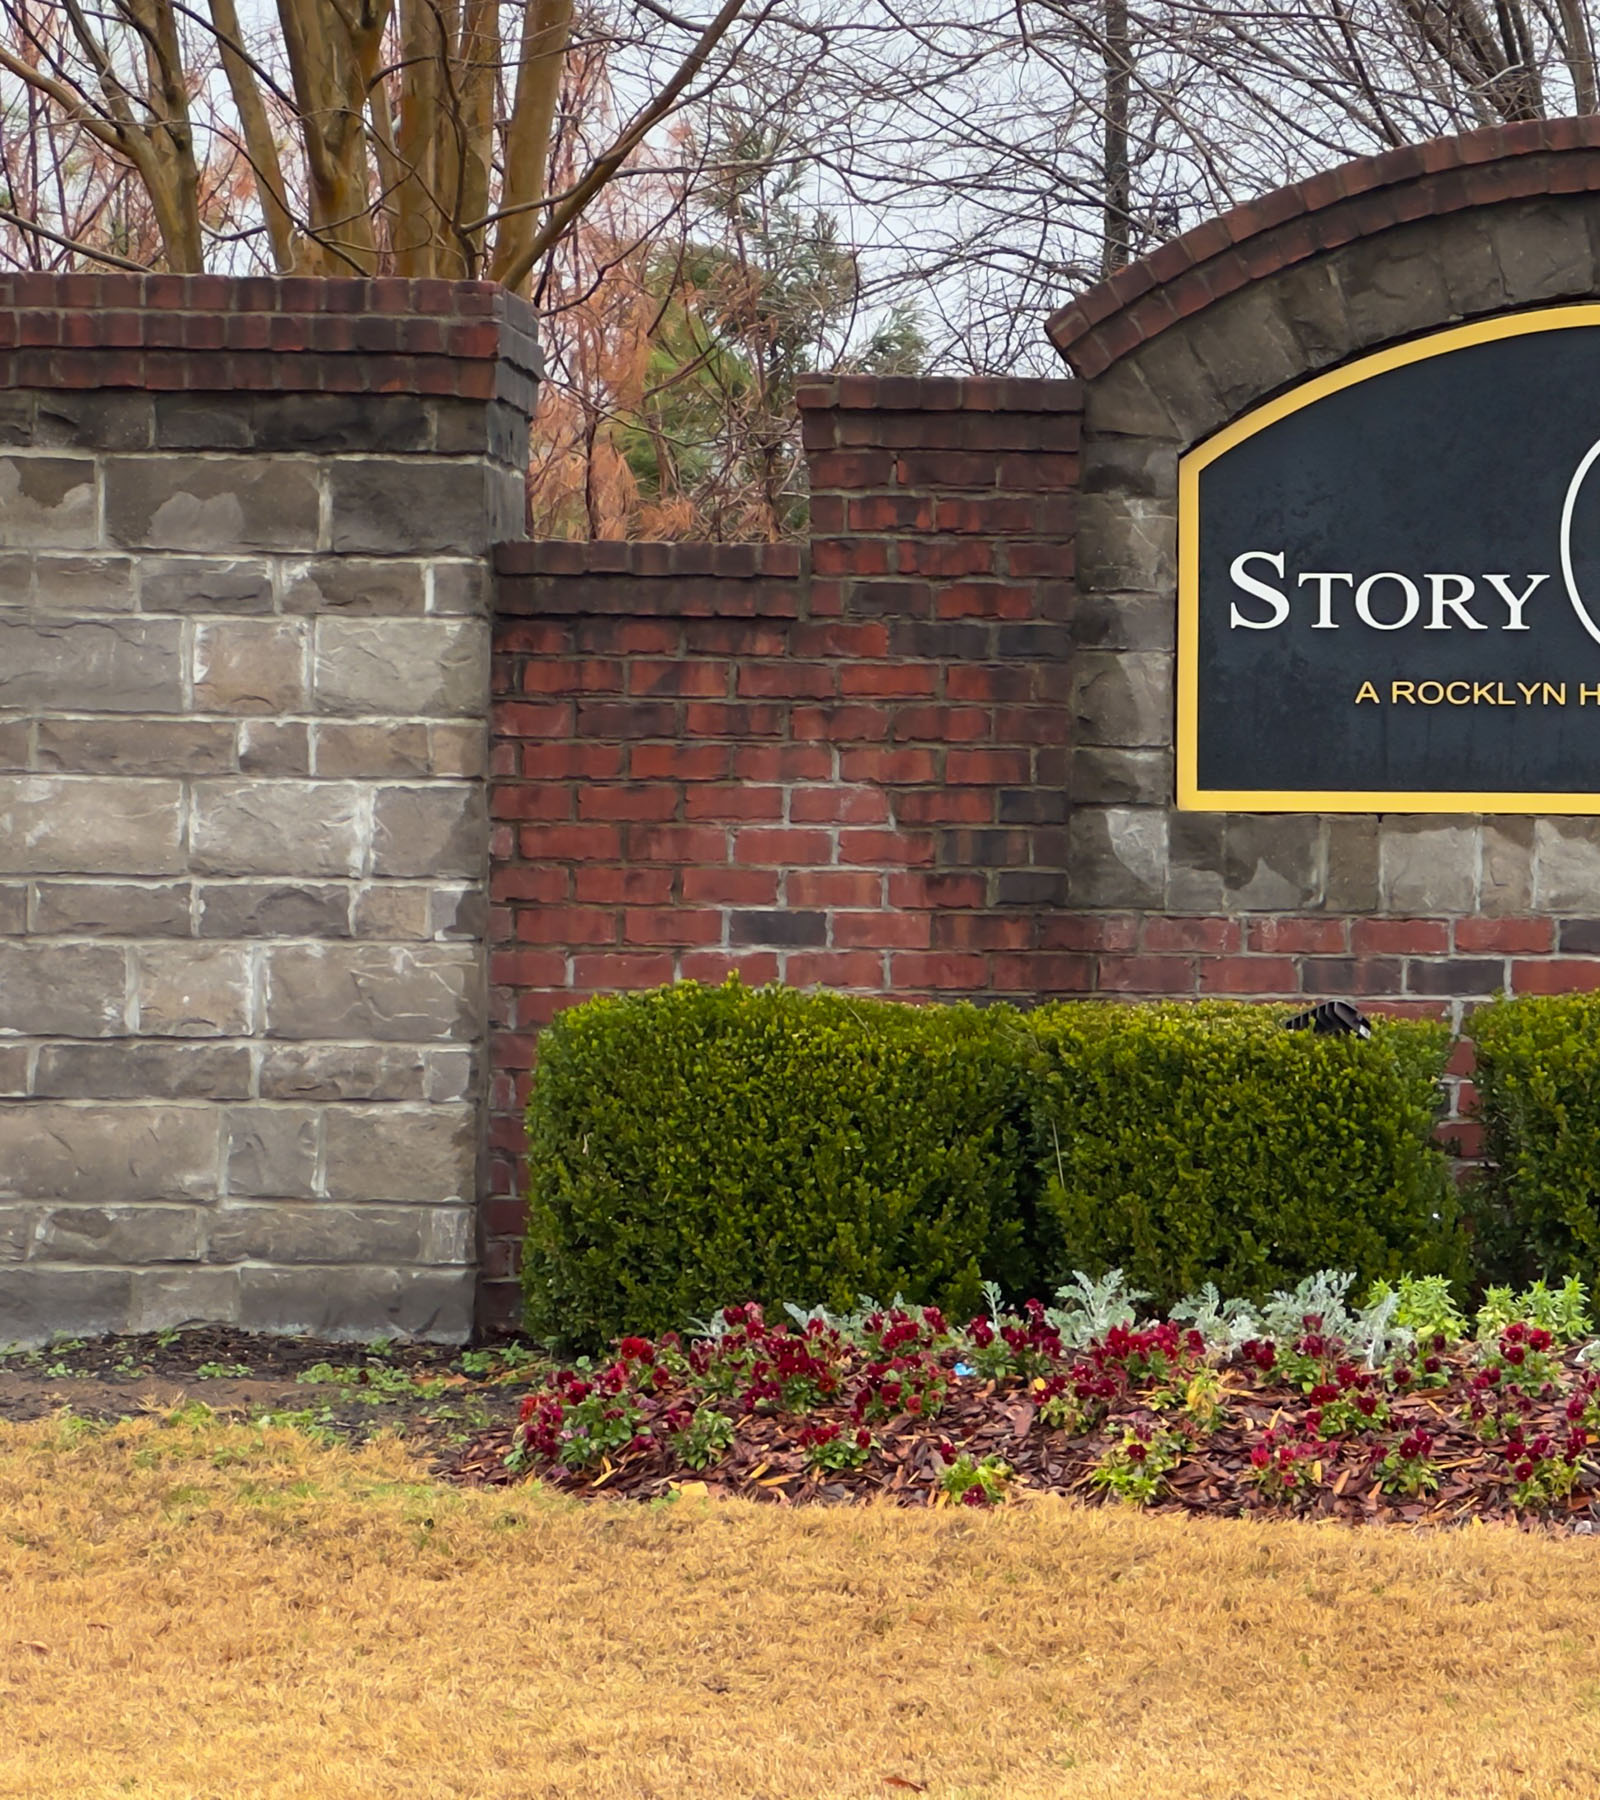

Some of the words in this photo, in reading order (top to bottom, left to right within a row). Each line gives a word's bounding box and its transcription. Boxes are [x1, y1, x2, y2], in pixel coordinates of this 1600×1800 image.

[1228, 550, 1551, 631] STORY
[1354, 680, 1381, 704] A
[1390, 680, 1567, 706] ROCKLYN
